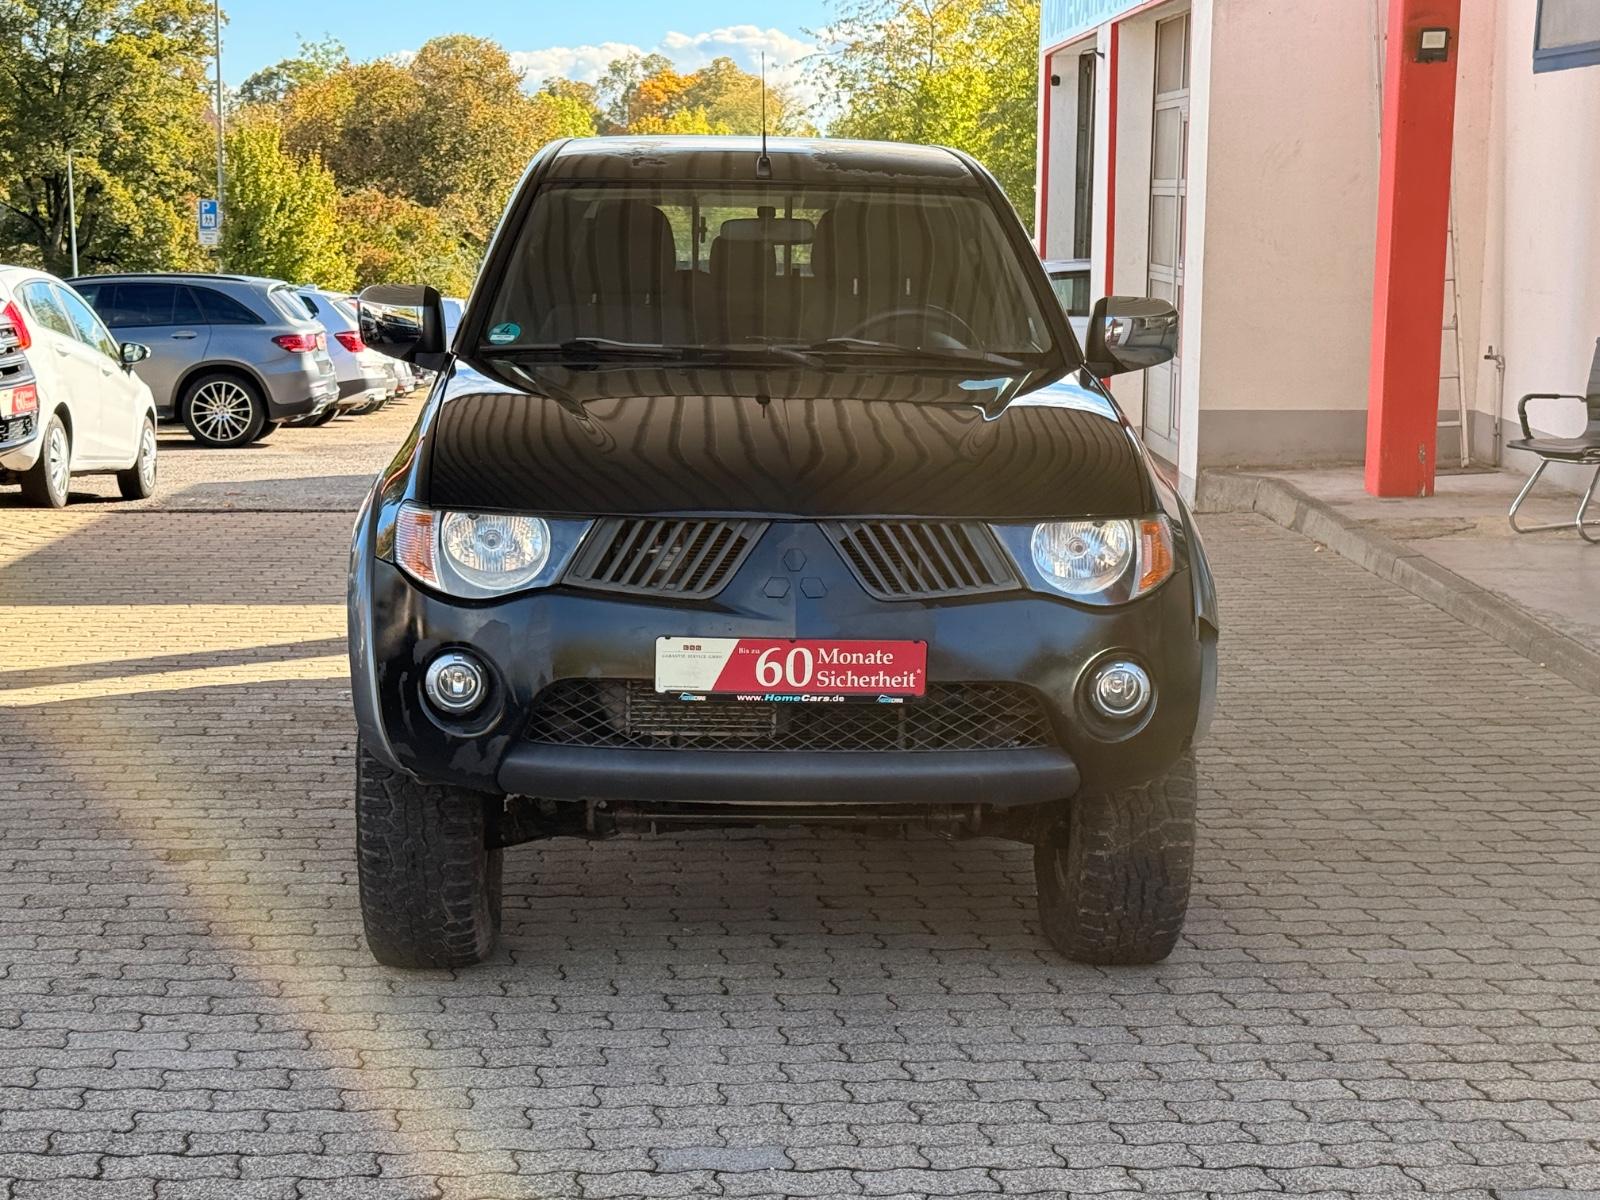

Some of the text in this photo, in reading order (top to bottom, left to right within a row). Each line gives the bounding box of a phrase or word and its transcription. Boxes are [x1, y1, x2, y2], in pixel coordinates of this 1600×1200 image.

[816, 647, 894, 665] Monate
[755, 646, 814, 688] 60
[736, 693, 845, 703] www.HomeCars.de
